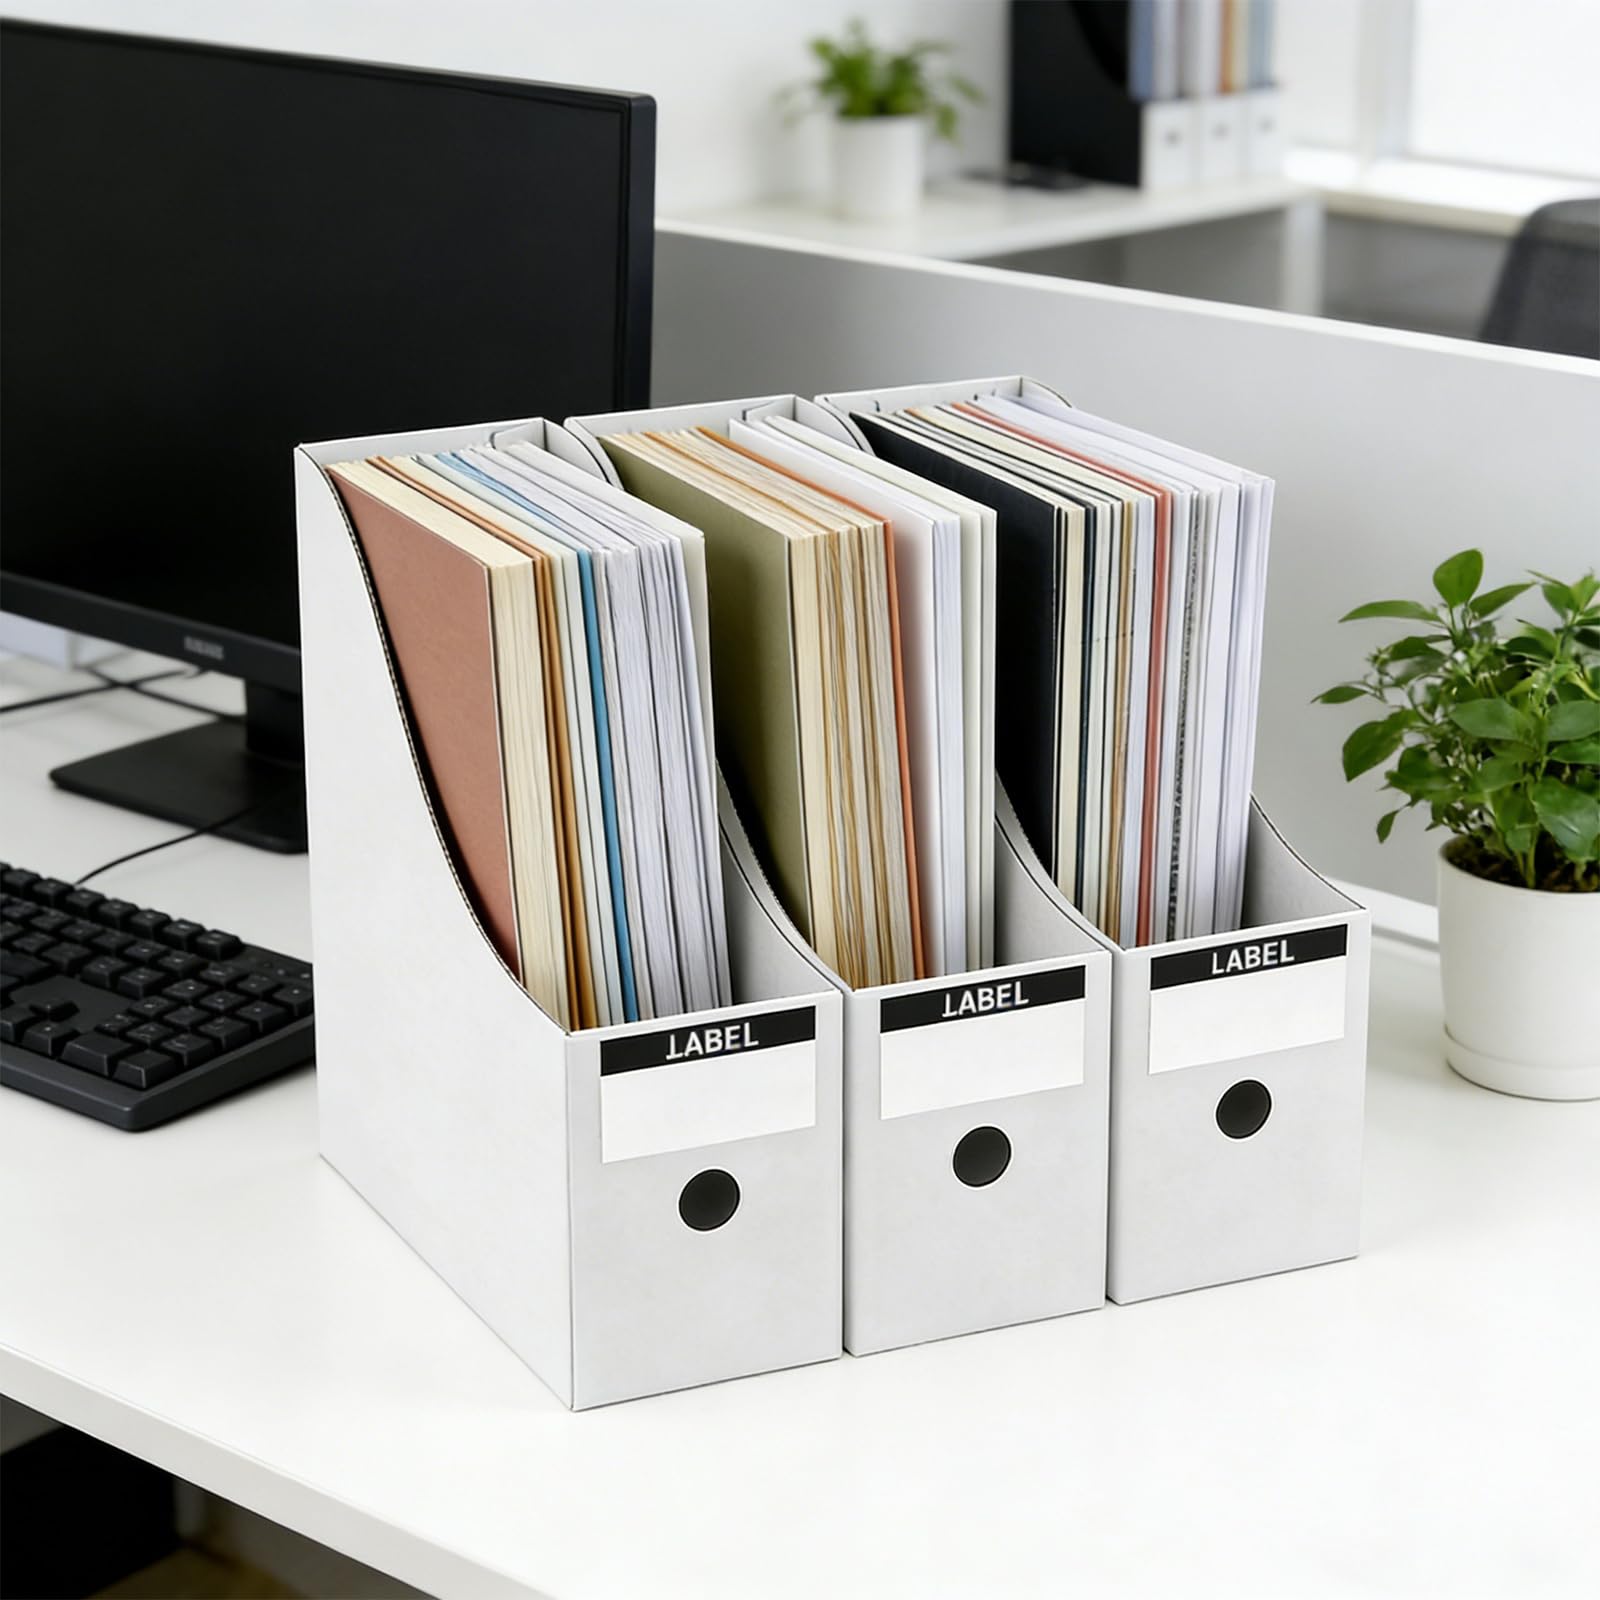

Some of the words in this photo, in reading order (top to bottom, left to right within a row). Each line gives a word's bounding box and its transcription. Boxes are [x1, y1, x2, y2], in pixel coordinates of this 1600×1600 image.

[1211, 939, 1295, 975] LABEL
[941, 980, 1030, 1018] LABEL
[665, 1021, 759, 1061] LABEL
